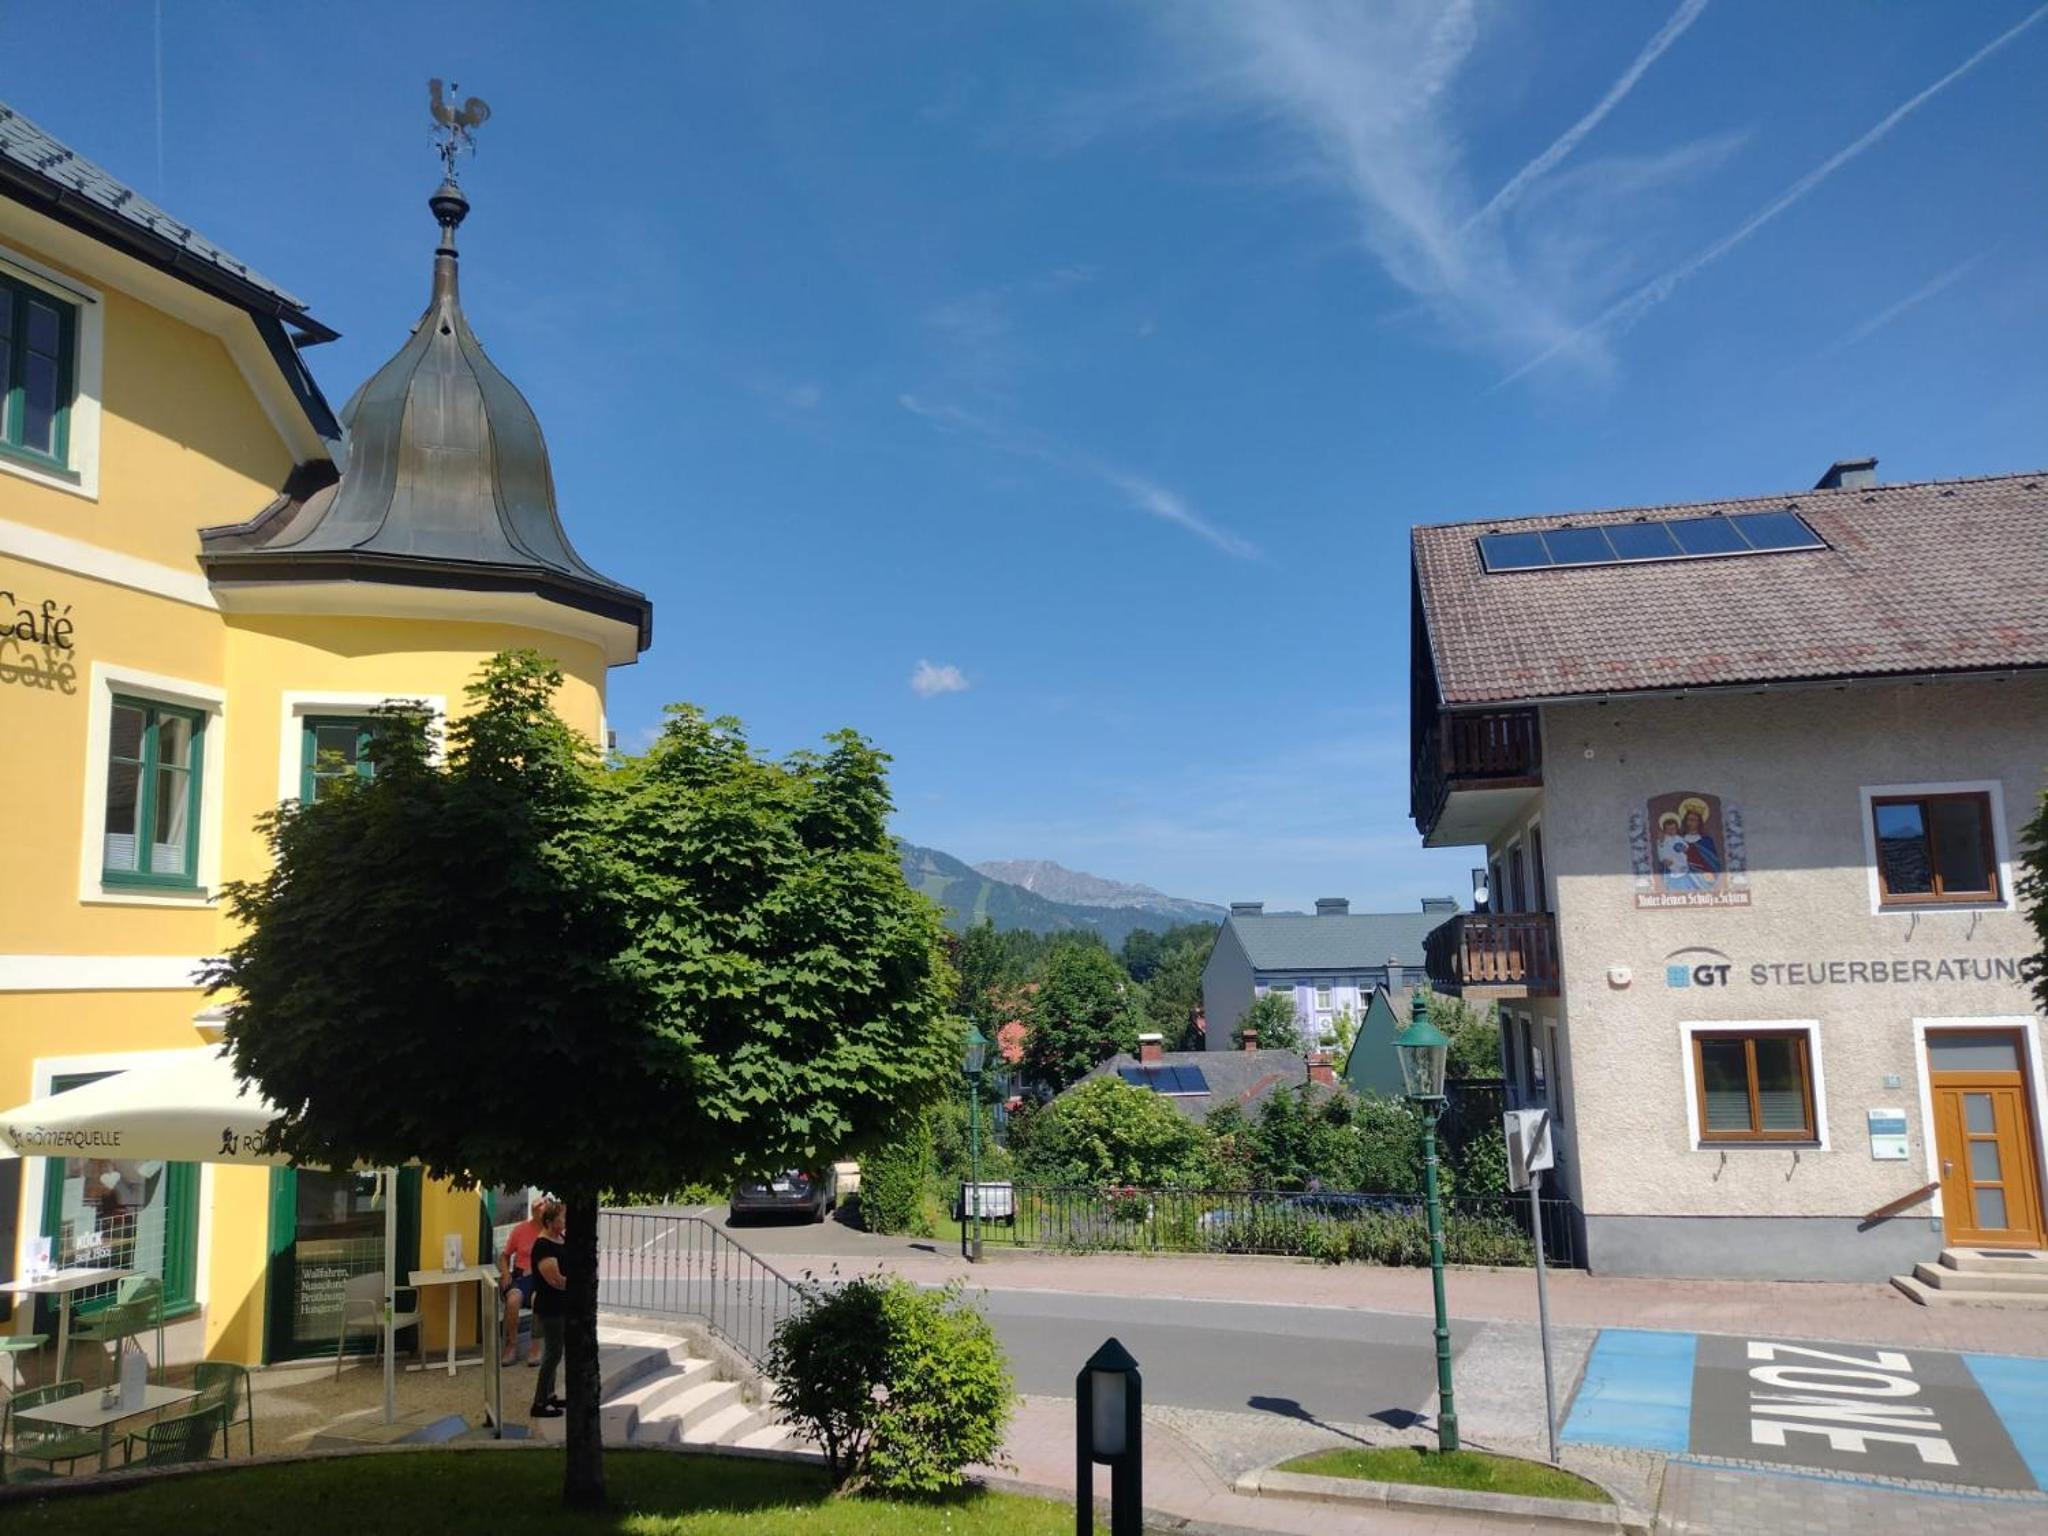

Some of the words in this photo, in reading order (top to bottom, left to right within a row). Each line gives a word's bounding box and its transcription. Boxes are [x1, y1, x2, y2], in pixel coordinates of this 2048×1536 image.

[0, 591, 73, 649] Café
[1693, 965, 1731, 986] GT
[1747, 1341, 1959, 1465] ZONE
